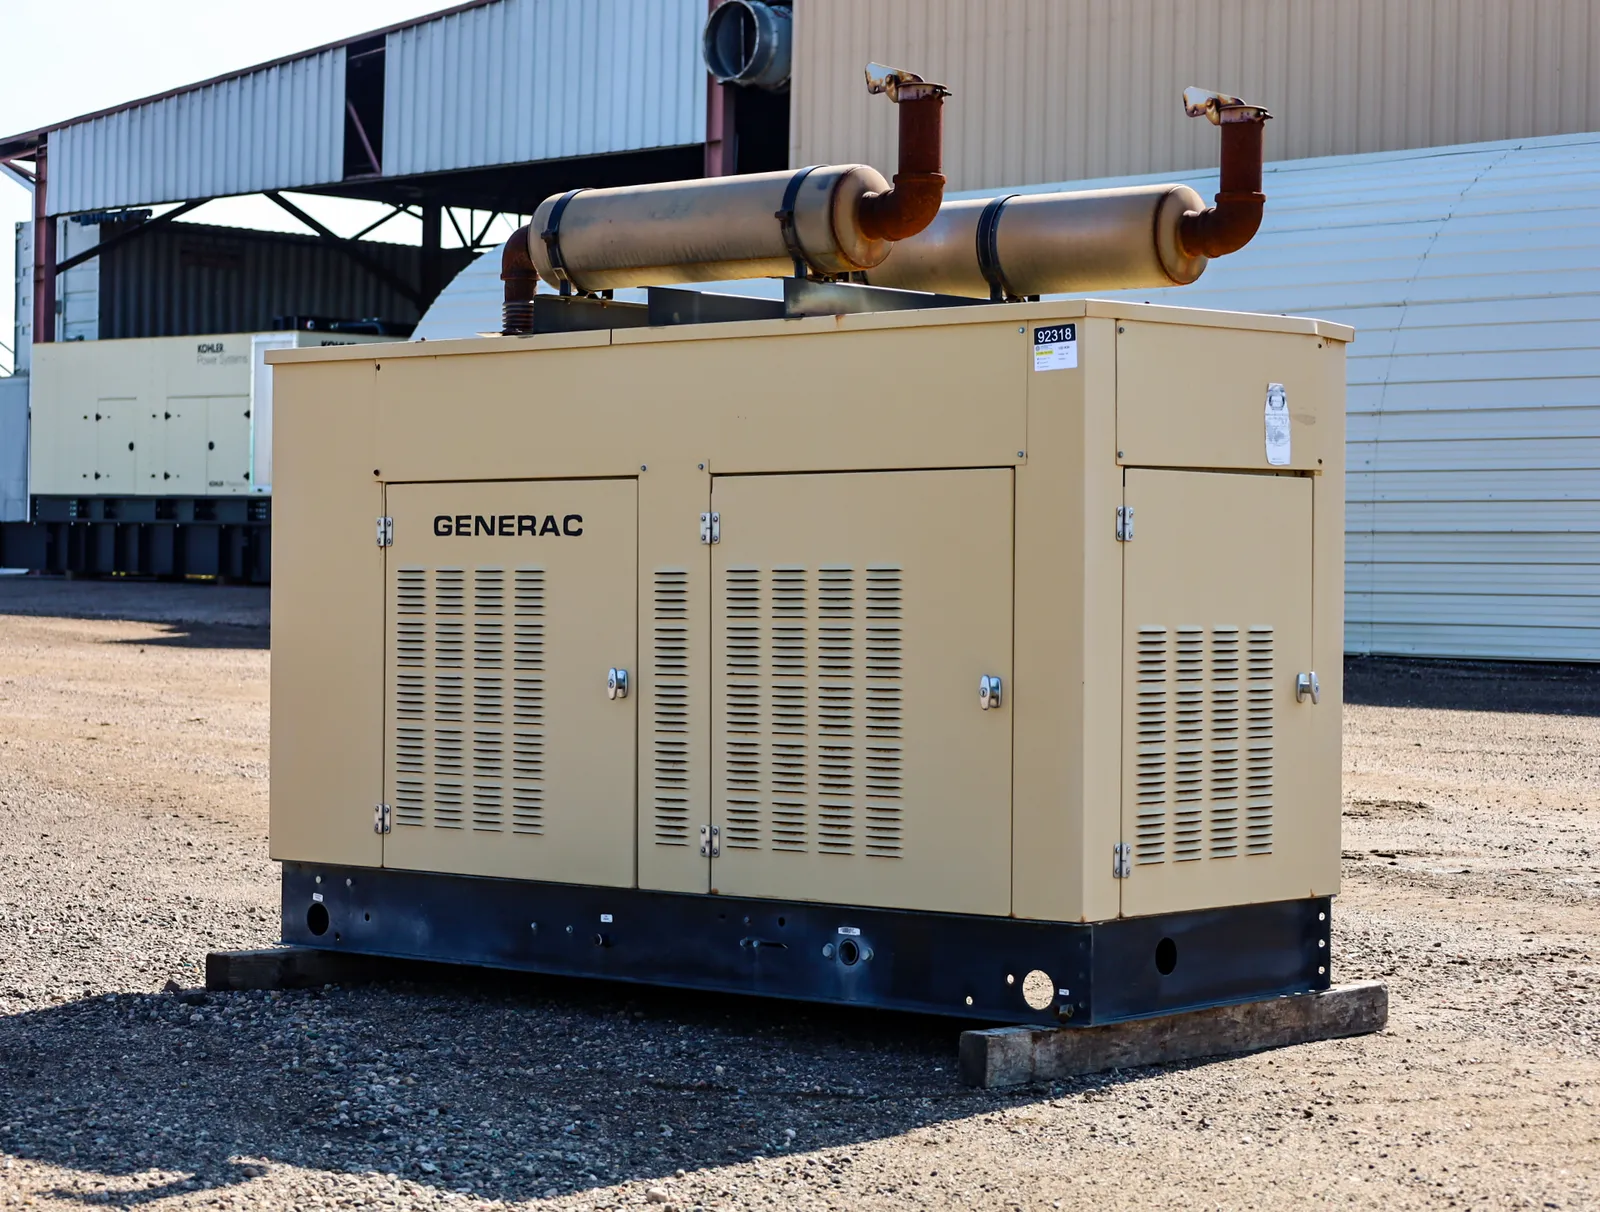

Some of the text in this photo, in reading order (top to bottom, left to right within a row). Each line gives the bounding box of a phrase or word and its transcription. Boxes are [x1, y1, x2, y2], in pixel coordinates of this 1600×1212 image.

[1037, 328, 1072, 343] 92318
[197, 343, 224, 353] KOHLER
[433, 514, 583, 537] GENERAC
